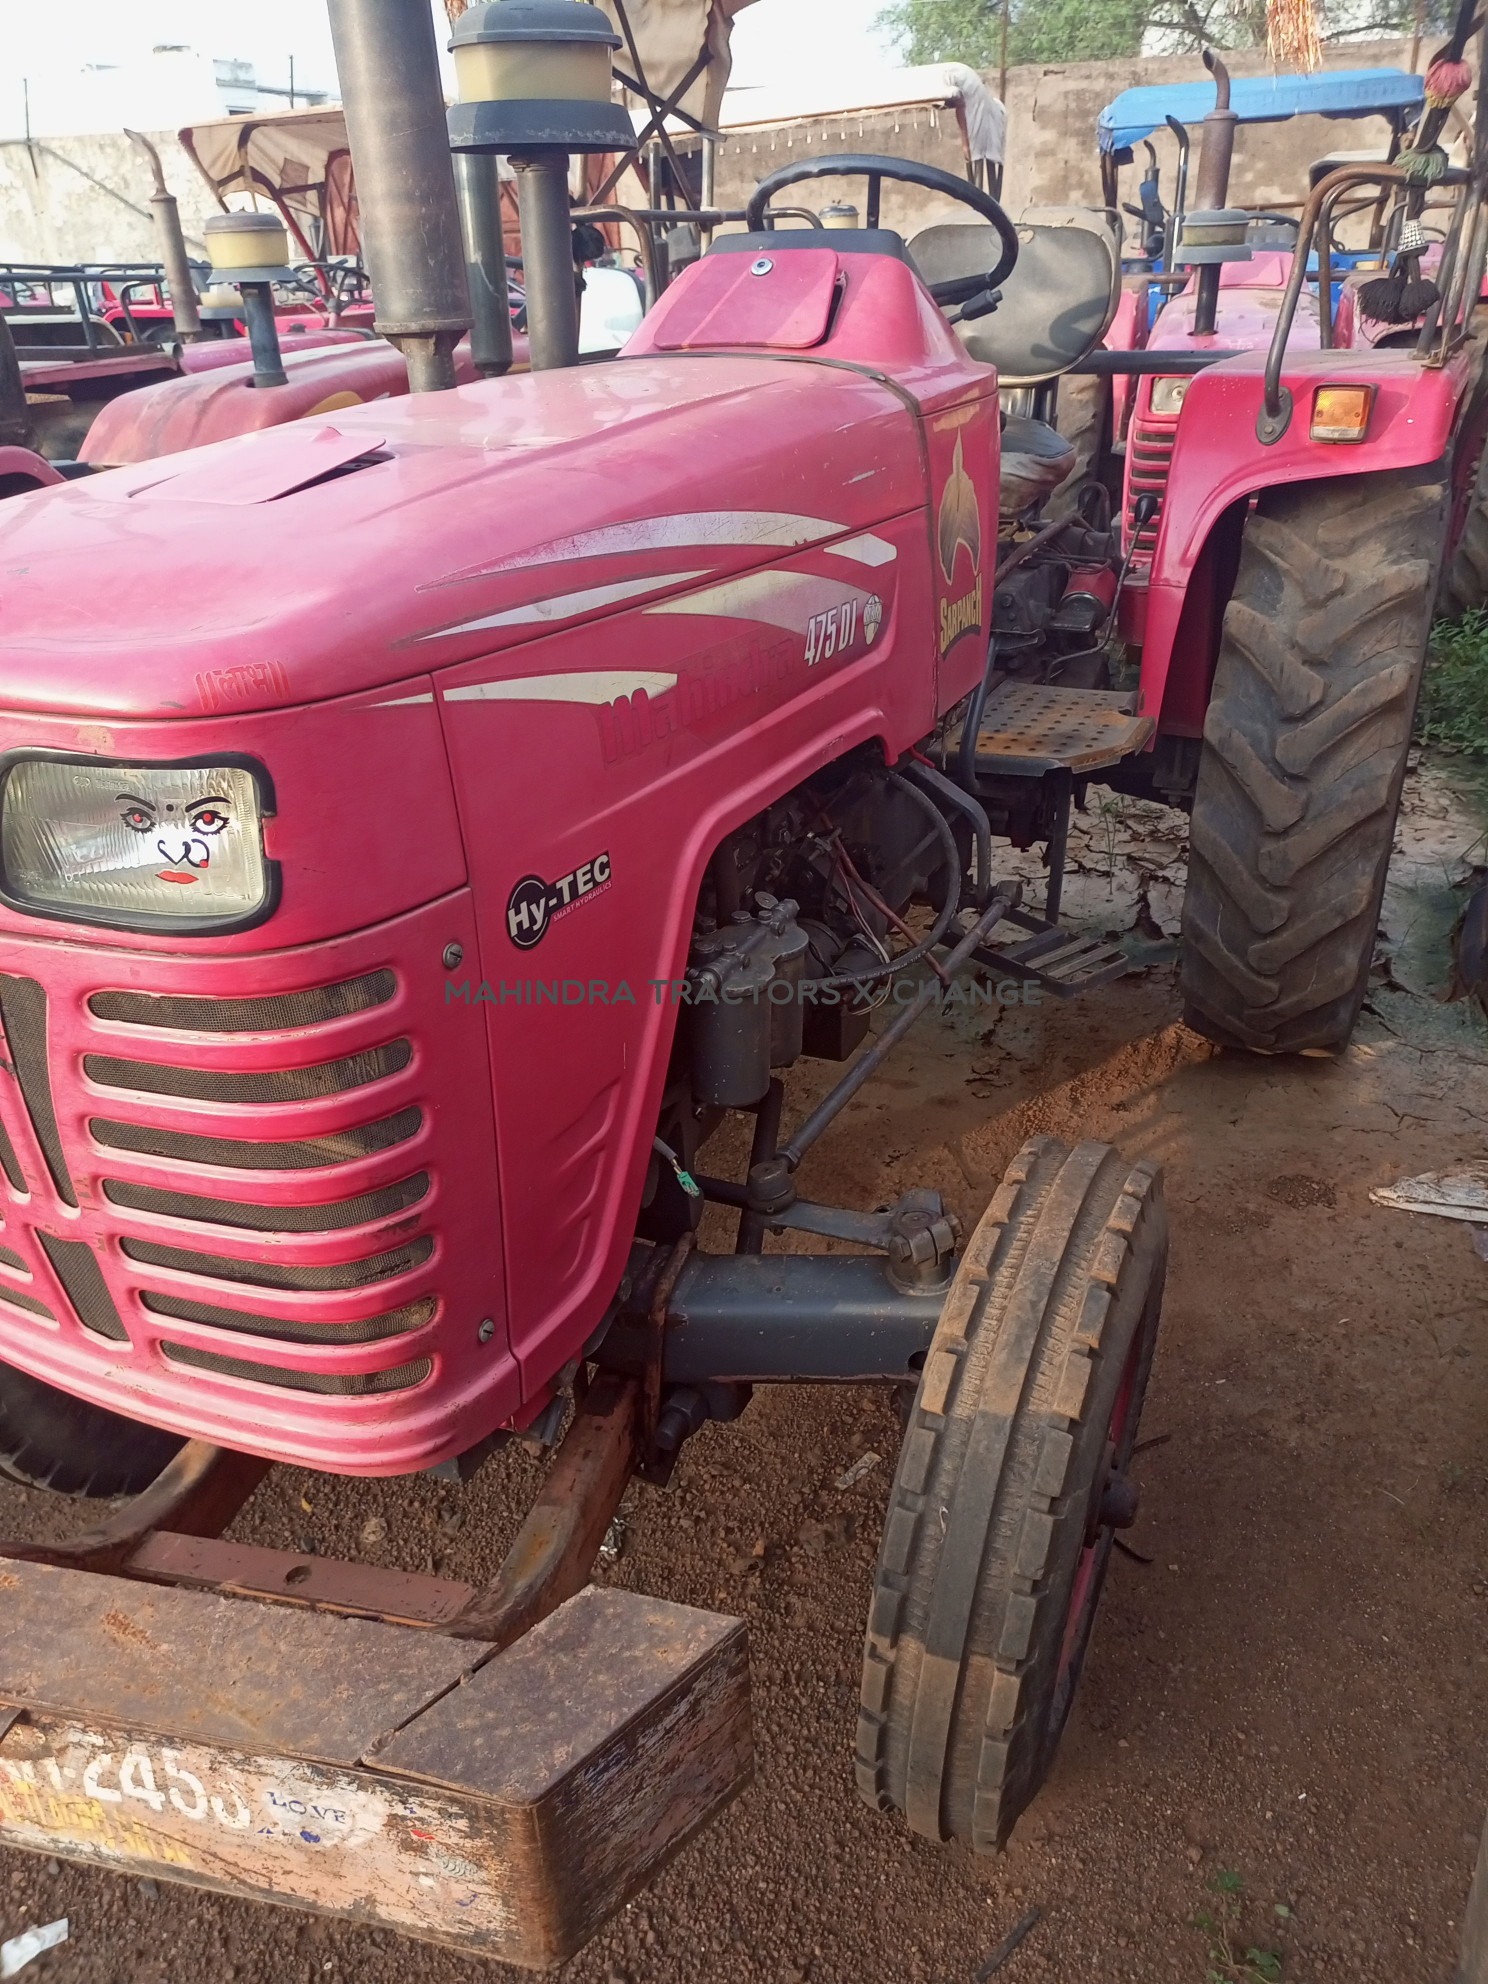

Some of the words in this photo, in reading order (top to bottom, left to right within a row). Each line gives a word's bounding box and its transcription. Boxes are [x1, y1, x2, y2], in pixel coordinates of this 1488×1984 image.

[803, 606, 838, 667] 475
[838, 597, 858, 653] DI
[940, 572, 982, 654] SARPANCH
[507, 853, 611, 938] Hy-TEC
[553, 903, 575, 922] SMART
[575, 880, 612, 909] HYDRAULICS
[265, 1790, 347, 1825] LOVE
